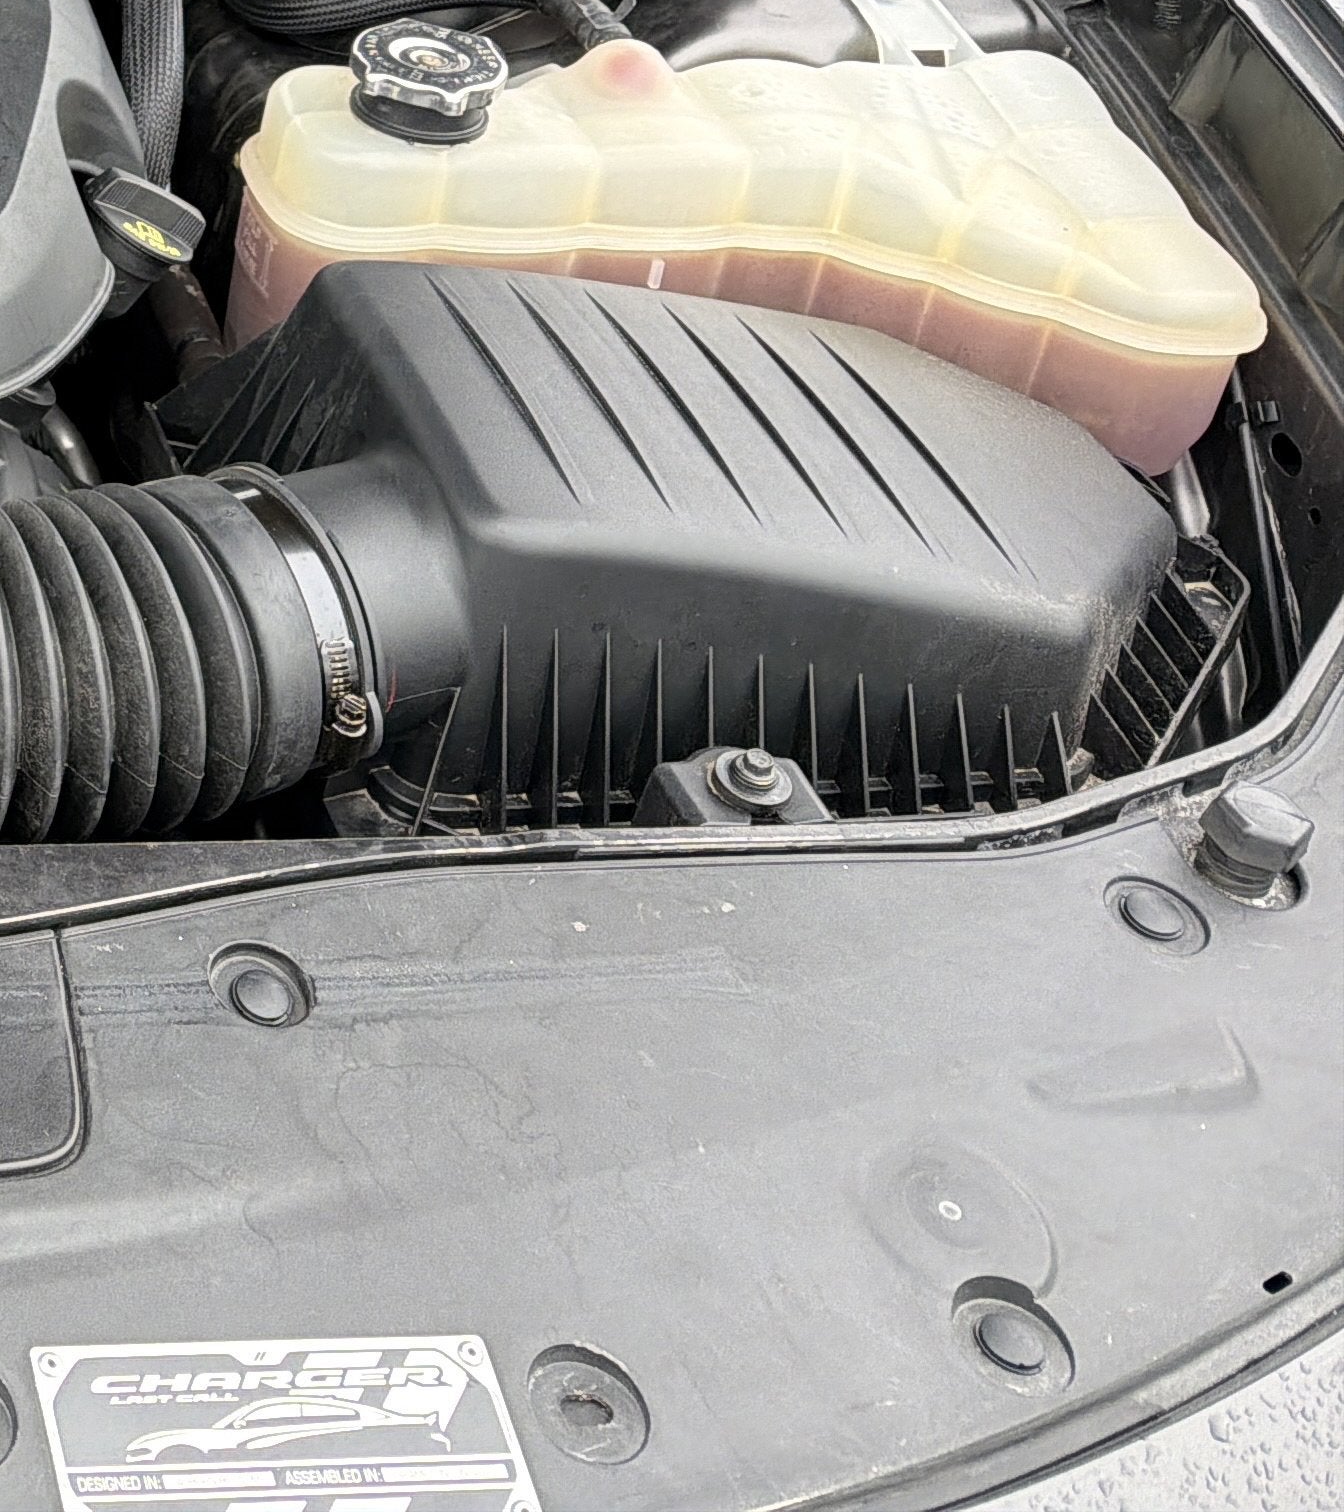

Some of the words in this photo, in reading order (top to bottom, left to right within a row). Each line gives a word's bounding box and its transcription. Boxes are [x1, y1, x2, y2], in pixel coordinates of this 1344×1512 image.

[90, 1366, 450, 1394] CHARGER
[76, 1474, 141, 1493] DESIGNED
[143, 1473, 162, 1490] IN:
[285, 1467, 362, 1486] ASSEMBLED
[363, 1467, 383, 1483] IN:
